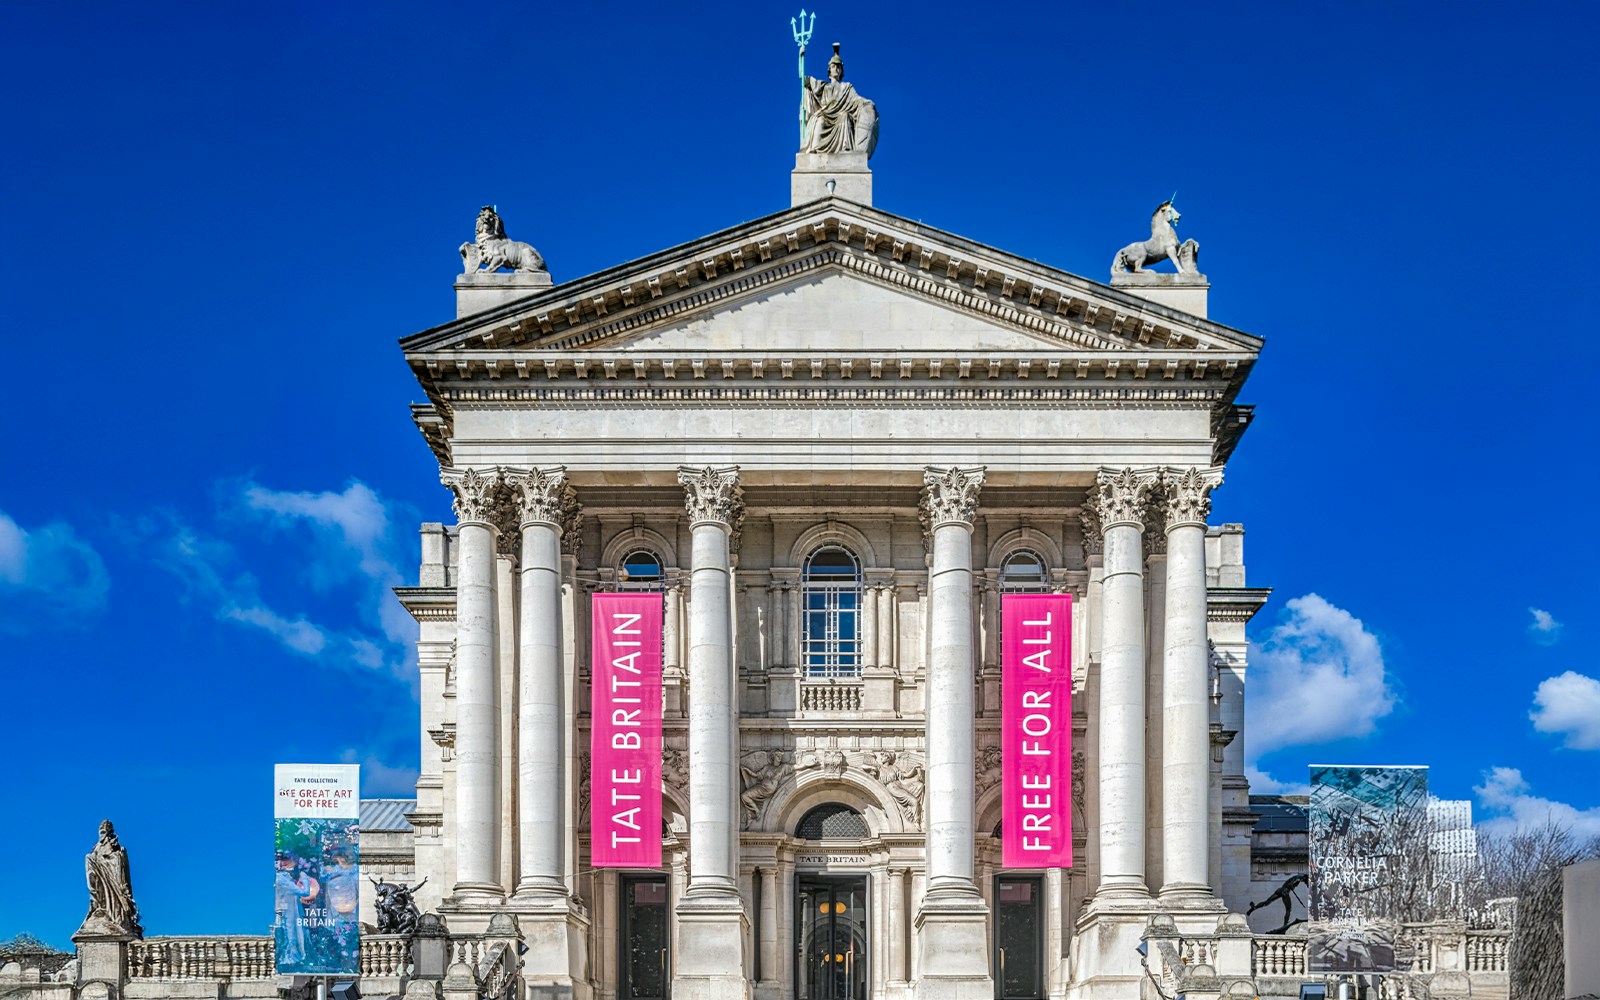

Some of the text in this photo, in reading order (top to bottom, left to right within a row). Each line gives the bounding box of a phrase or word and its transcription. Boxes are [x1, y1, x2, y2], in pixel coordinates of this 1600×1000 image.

[612, 613, 641, 848] TATE BRITAIN
[1023, 612, 1051, 850] FREE FOR ALL
[299, 789, 330, 798] GREAT
[334, 789, 353, 798] ART
[294, 799, 338, 808] FOR FREE
[1316, 856, 1387, 869] CORNELIA
[1324, 871, 1378, 884] PARKER
[304, 908, 327, 917] TATE
[1340, 908, 1362, 916] TATE
[296, 918, 336, 927] BRITAIN
